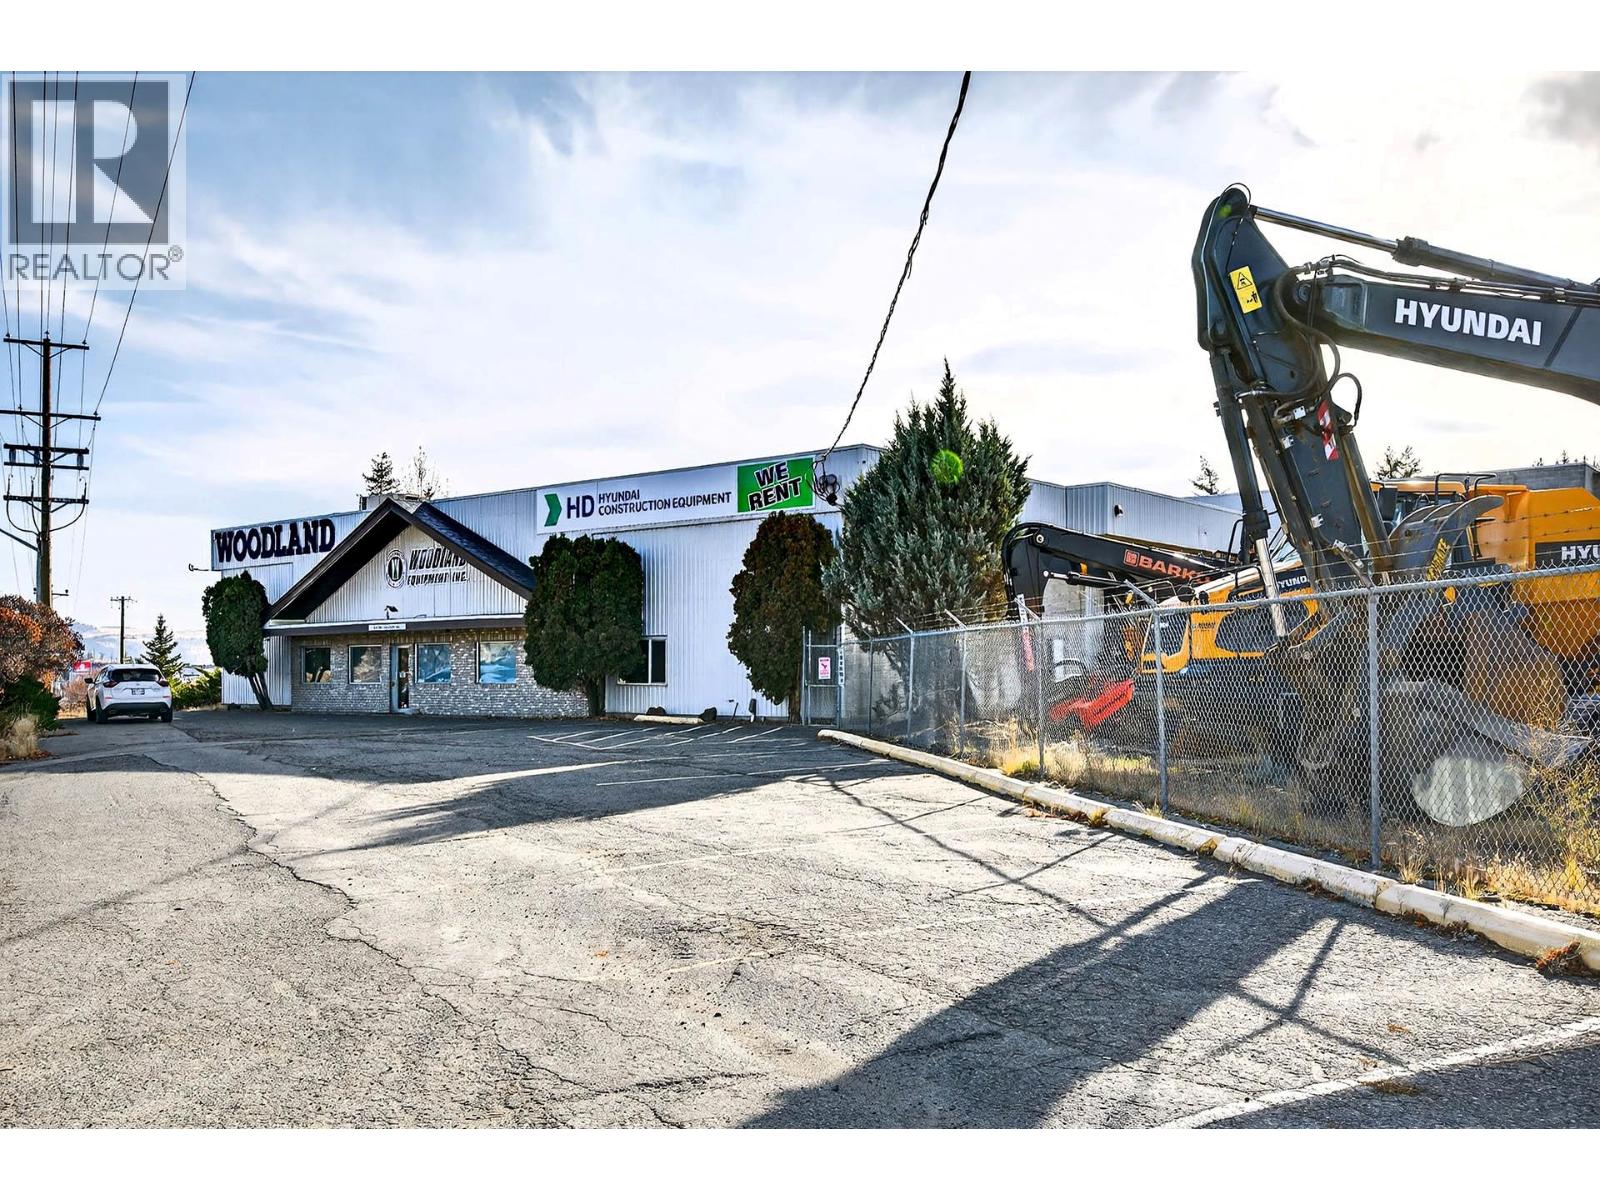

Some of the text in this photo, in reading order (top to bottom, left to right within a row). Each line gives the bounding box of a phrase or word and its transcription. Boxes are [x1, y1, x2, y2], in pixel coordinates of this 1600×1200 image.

[1394, 298, 1542, 346] HYUNDAI
[754, 461, 789, 488] WE
[566, 495, 595, 519] HD
[598, 489, 640, 504] HYUNDAI
[598, 491, 732, 516] CONSTRUCTION EQUIPMENT
[748, 477, 802, 512] RENT
[215, 518, 336, 562] WOODLAND
[1277, 575, 1308, 588] YUND
